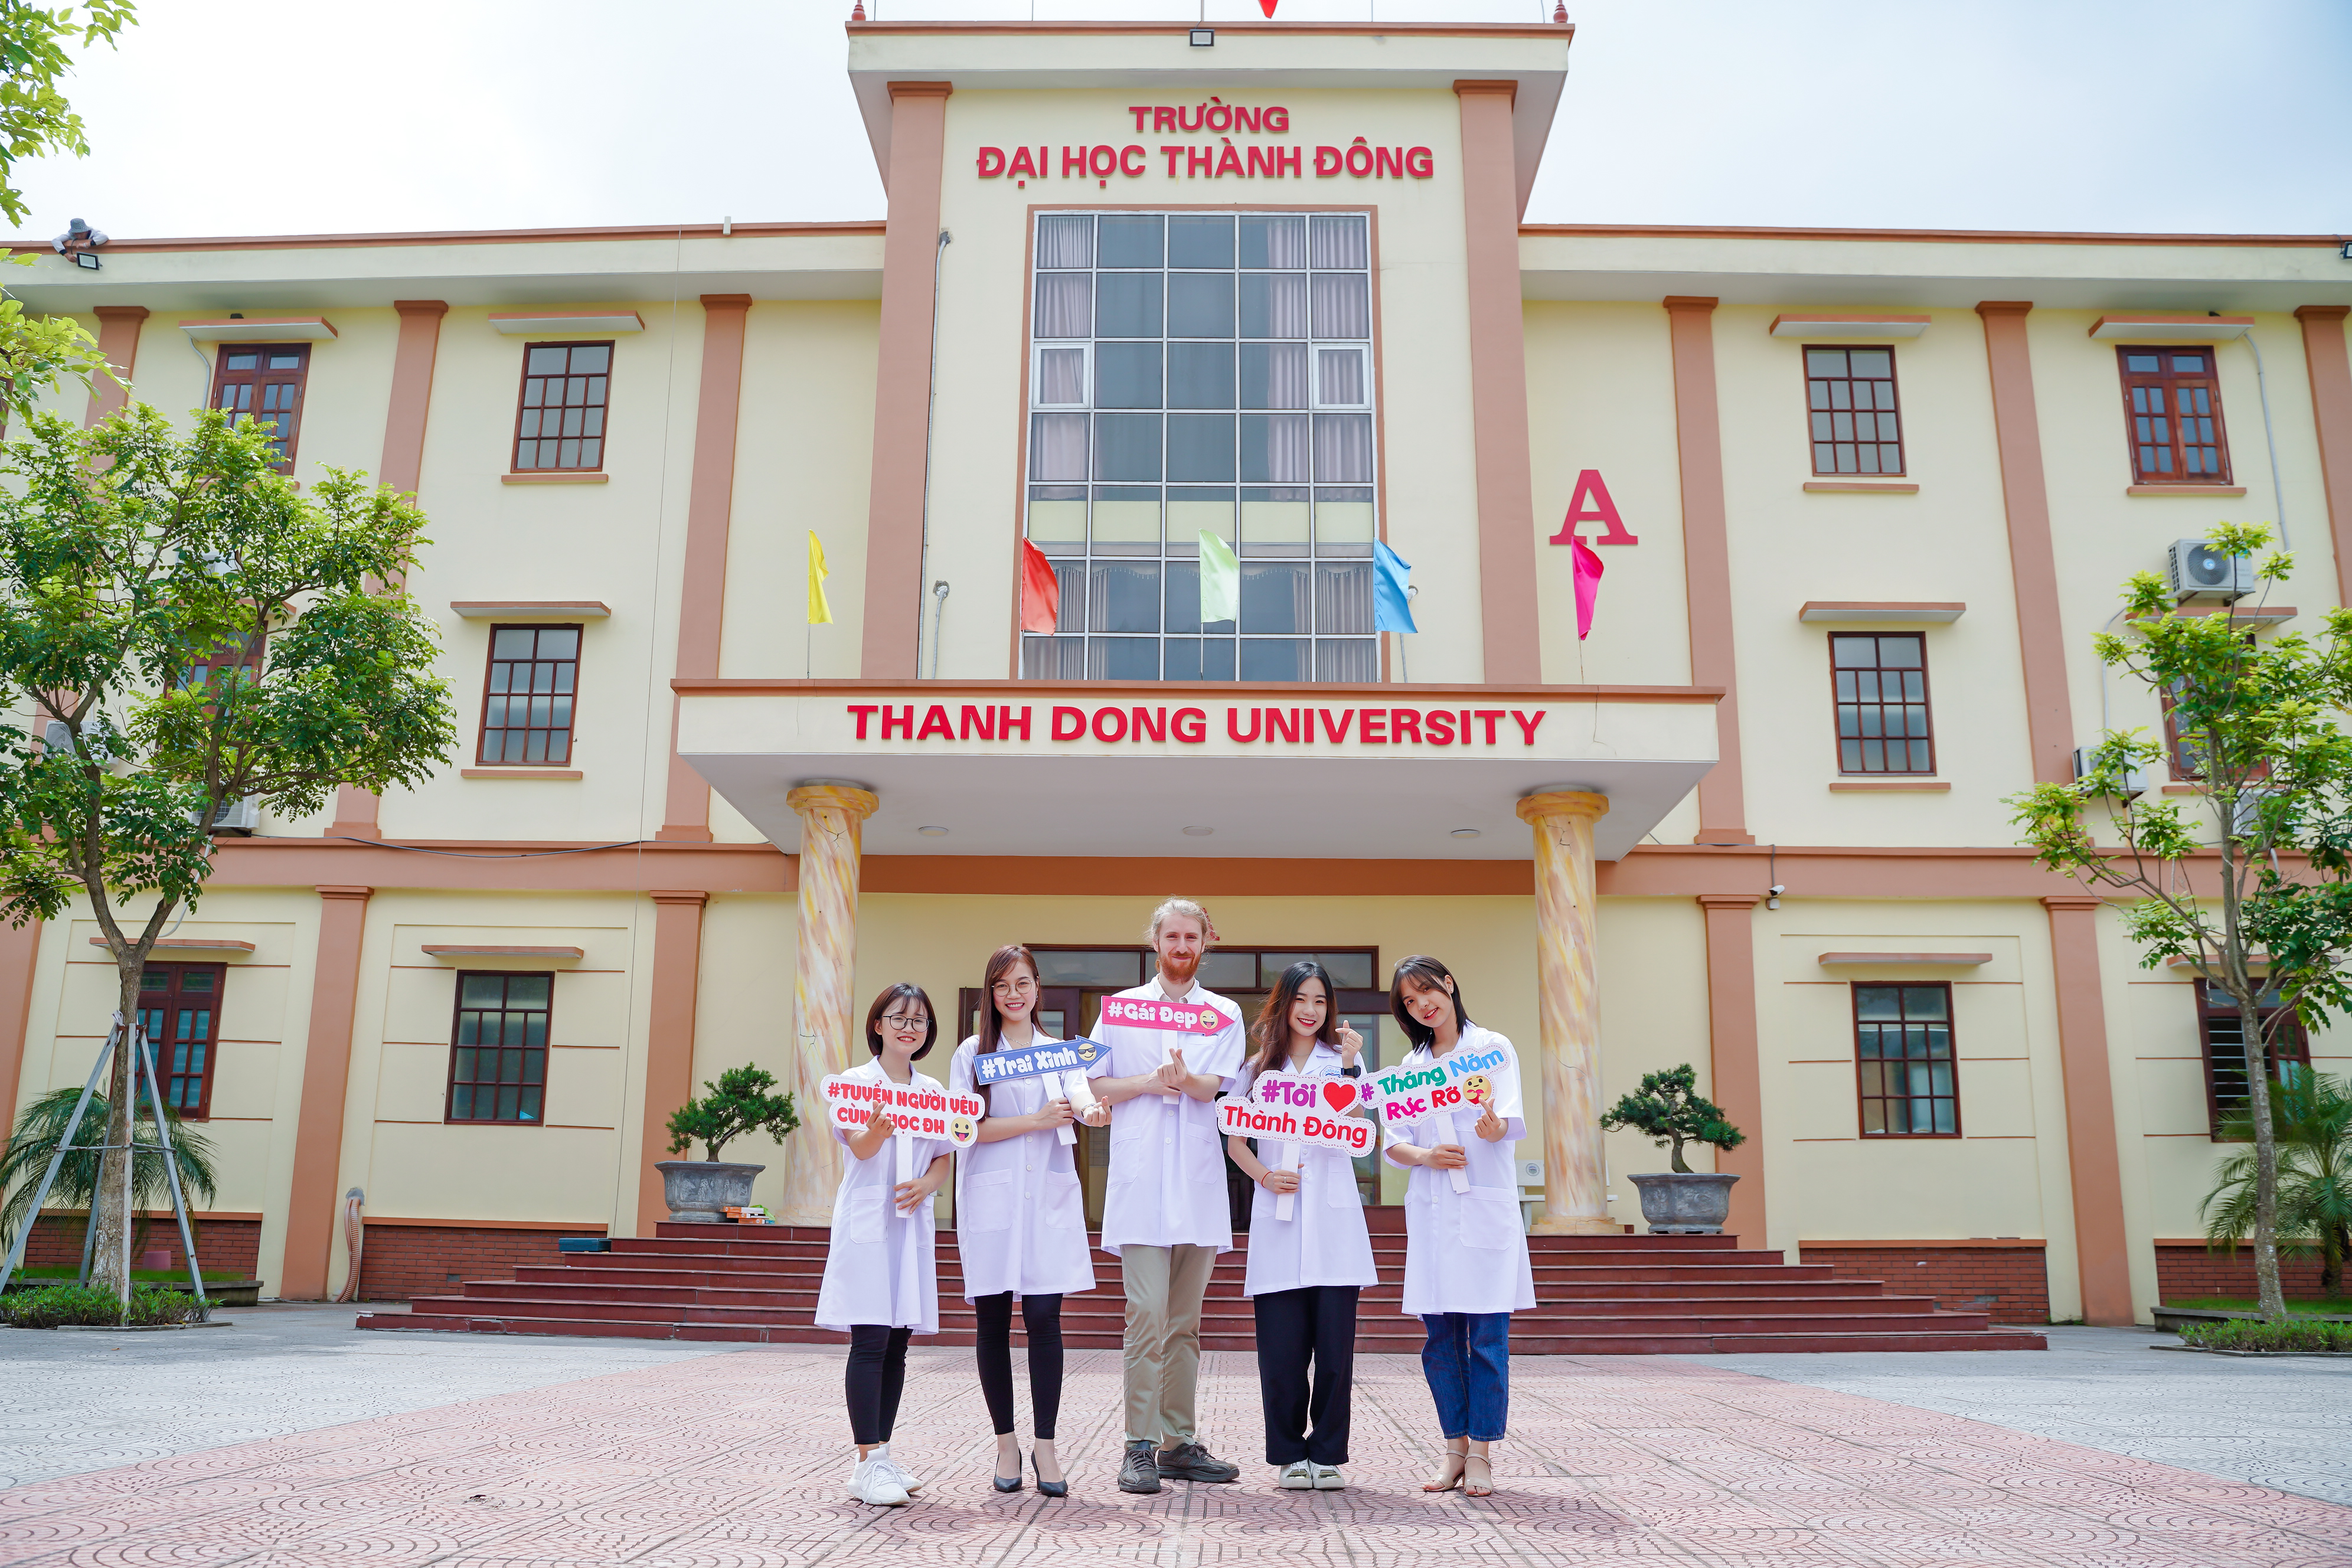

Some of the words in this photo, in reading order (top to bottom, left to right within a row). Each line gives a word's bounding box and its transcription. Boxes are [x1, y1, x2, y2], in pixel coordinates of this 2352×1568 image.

[1128, 96, 1289, 133] TRƯỜNG
[976, 146, 1048, 189] ĐẠI
[1062, 145, 1146, 188] HỌC
[1160, 137, 1302, 178] THÀNH
[1313, 136, 1434, 179] ĐÔNG
[1550, 469, 1638, 545] A
[847, 705, 1031, 741] THANH
[1051, 706, 1207, 744] DONG
[1227, 708, 1546, 746] UNIVERSITY
[1108, 1001, 1157, 1021] #Gái
[1159, 1006, 1198, 1029] Đẹp
[981, 1054, 1034, 1082] #Trai
[1034, 1047, 1078, 1071] Xinh
[1377, 1066, 1447, 1095] Tháng
[1448, 1050, 1505, 1077] Năm
[828, 1080, 893, 1105] #TUYỂN
[897, 1088, 946, 1112] NGƯỜI
[950, 1095, 979, 1116] YÊU
[1386, 1097, 1427, 1121] Rực
[1430, 1086, 1461, 1108] Rỡ
[837, 1103, 872, 1125] CÙN
[922, 1118, 945, 1134] ĐH
[1224, 1105, 1296, 1134] Thành
[1302, 1116, 1368, 1148] Đông
